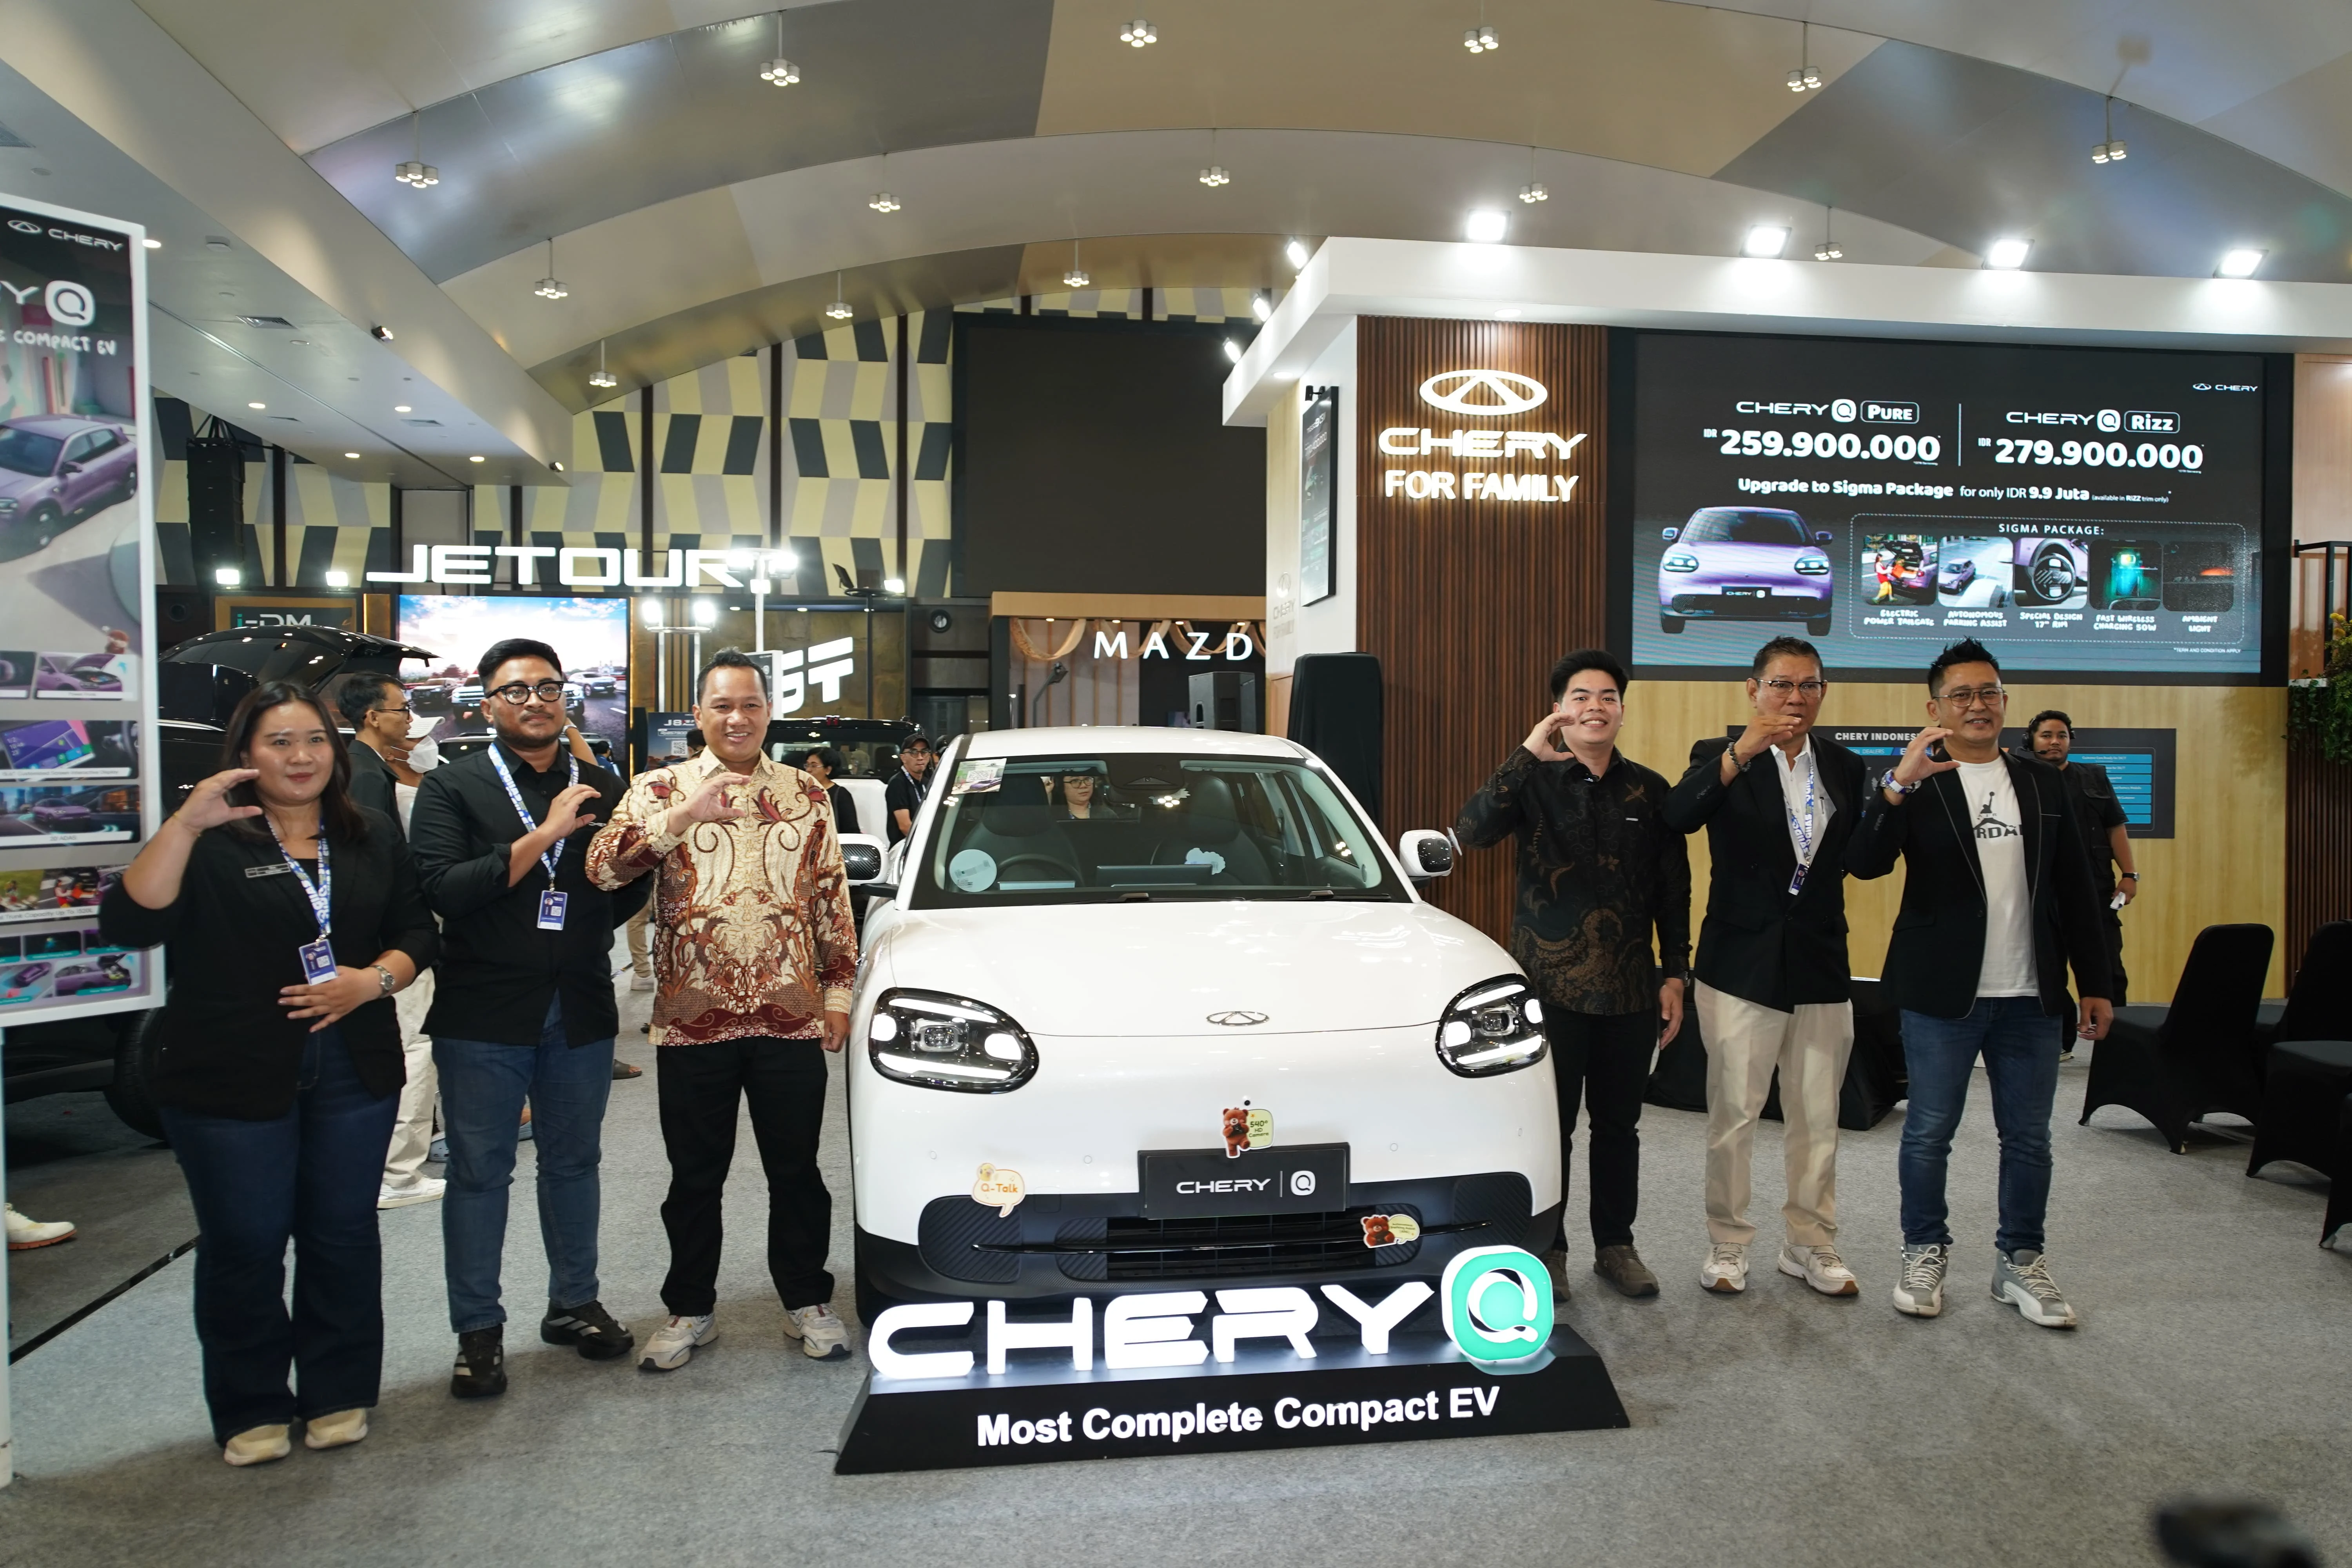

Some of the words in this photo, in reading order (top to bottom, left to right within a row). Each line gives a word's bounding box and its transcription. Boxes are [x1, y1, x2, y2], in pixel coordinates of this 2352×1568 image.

[48, 229, 123, 251] CHERY
[13, 330, 90, 352] COMPACT
[97, 340, 116, 355] EV
[1736, 401, 1829, 415] CHERY
[2006, 412, 2094, 425] CHERY
[2132, 414, 2173, 431] Rizz
[1703, 429, 1717, 438] IDR
[1378, 427, 1588, 459] CHERY
[1978, 437, 1991, 447] IDR
[1385, 470, 1456, 499] FOR
[1463, 472, 1579, 502] FAMILY
[1738, 478, 1809, 494] Upgrade
[1811, 480, 1830, 493] to
[1833, 480, 1883, 497] Sigma
[1886, 482, 1954, 499] Package
[1960, 485, 1976, 497] for
[1978, 486, 2004, 500] only
[2006, 488, 2026, 498] IDR
[2029, 486, 2053, 499] 9.9
[2054, 487, 2090, 500] Juta
[1998, 523, 2038, 534] SIGMA
[2044, 525, 2105, 535] PACKAGE:
[366, 544, 744, 587] JETOUR
[1880, 609, 1919, 618] ELECTRIC
[1947, 611, 2004, 619] AUTONOMOUS
[2020, 612, 2051, 621] SPECIAL
[2053, 613, 2083, 621] DESIGN
[1864, 617, 1894, 625] POWER
[1898, 618, 1935, 626] TAILGATE
[1943, 619, 1978, 627] PARKING
[2093, 622, 2133, 631] CHARGING
[2136, 623, 2156, 632] 50W
[1835, 732, 1869, 740] CHERY
[981, 1183, 1018, 1193] Q-Talk
[1176, 1178, 1271, 1194] CHERY
[868, 1281, 1435, 1378] CHERY
[978, 1411, 1072, 1447] Most
[1082, 1398, 1264, 1443] Complete
[1273, 1389, 1438, 1433] Compact
[1448, 1385, 1501, 1419] EV
